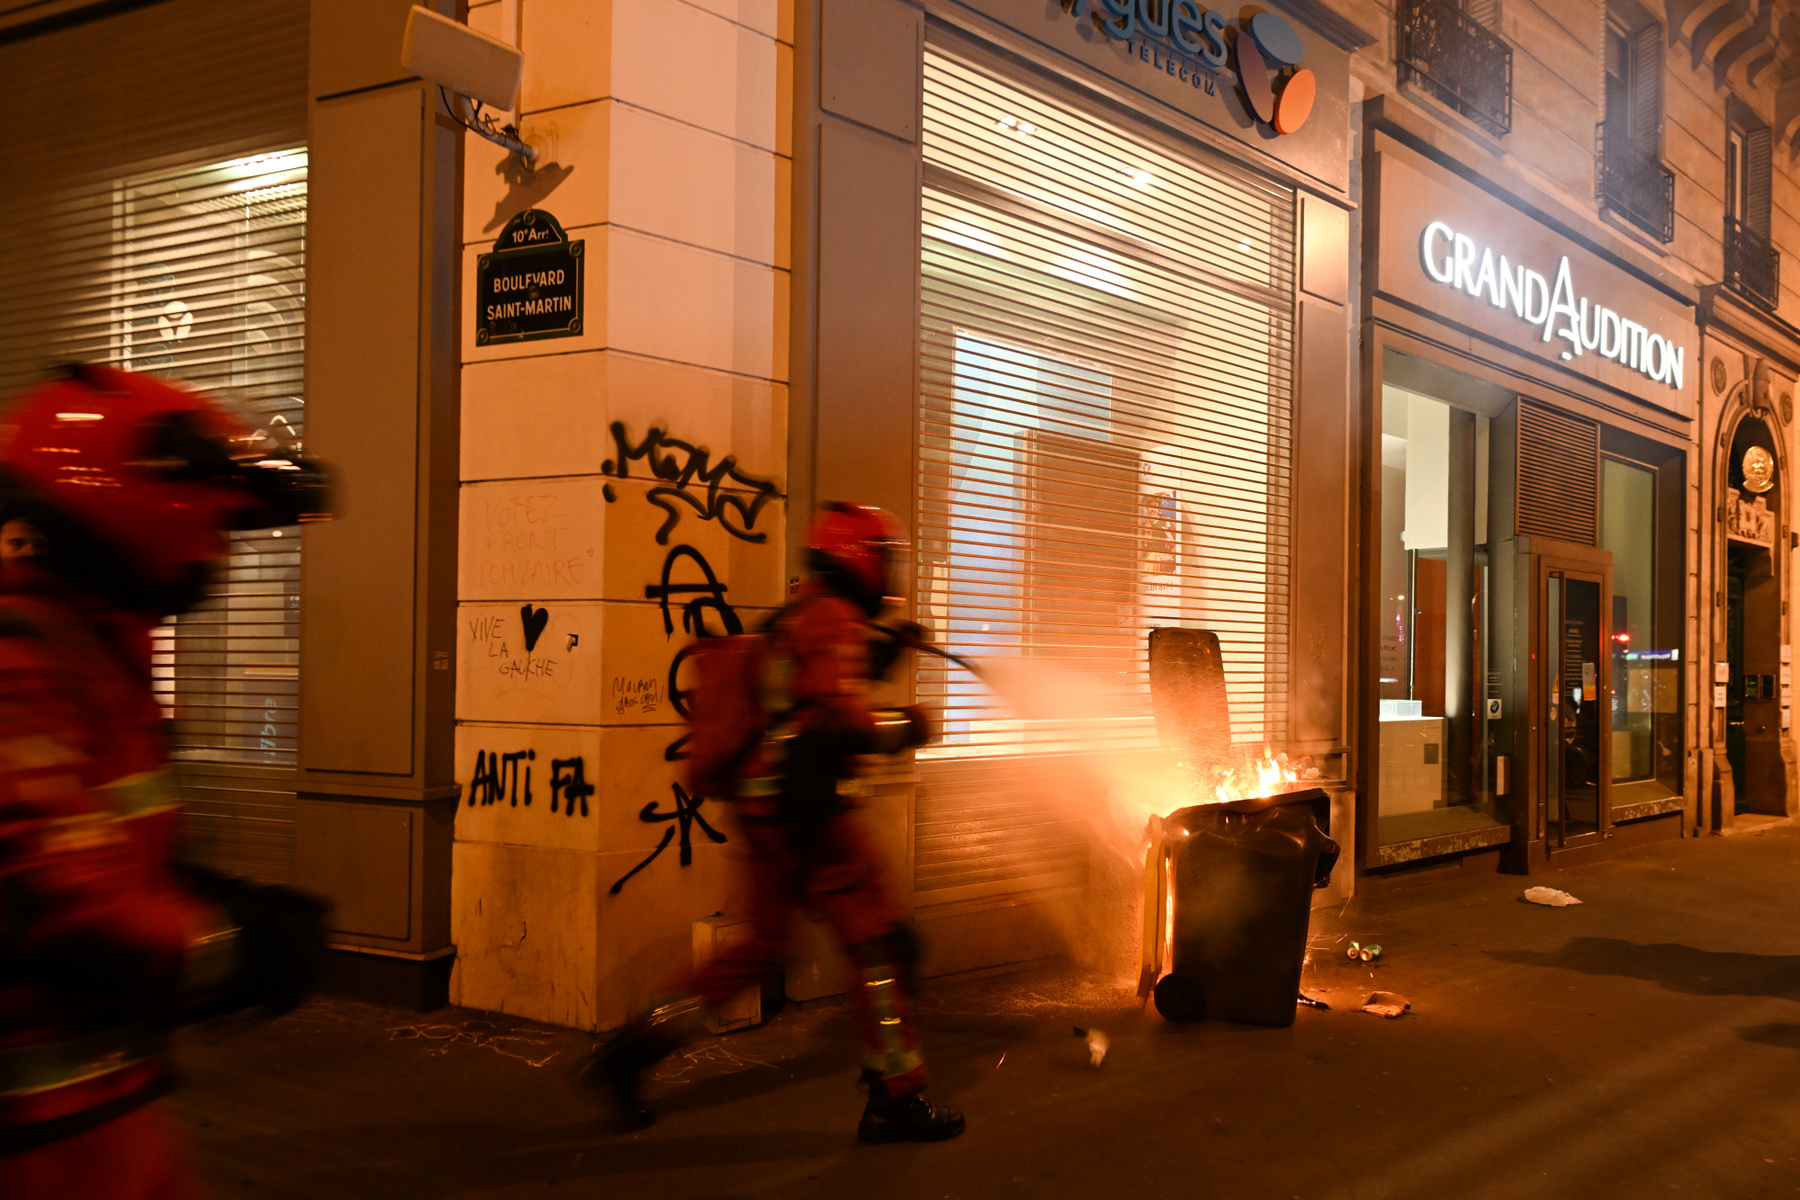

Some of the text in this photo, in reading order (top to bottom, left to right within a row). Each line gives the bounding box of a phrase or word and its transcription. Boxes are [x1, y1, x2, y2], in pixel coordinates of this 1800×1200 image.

[1127, 39, 1216, 97] TELECOM
[493, 269, 565, 293] BOULEVARD
[487, 295, 572, 320] SAINT-MARTIN
[489, 641, 508, 658] LA
[549, 756, 595, 817] FA
